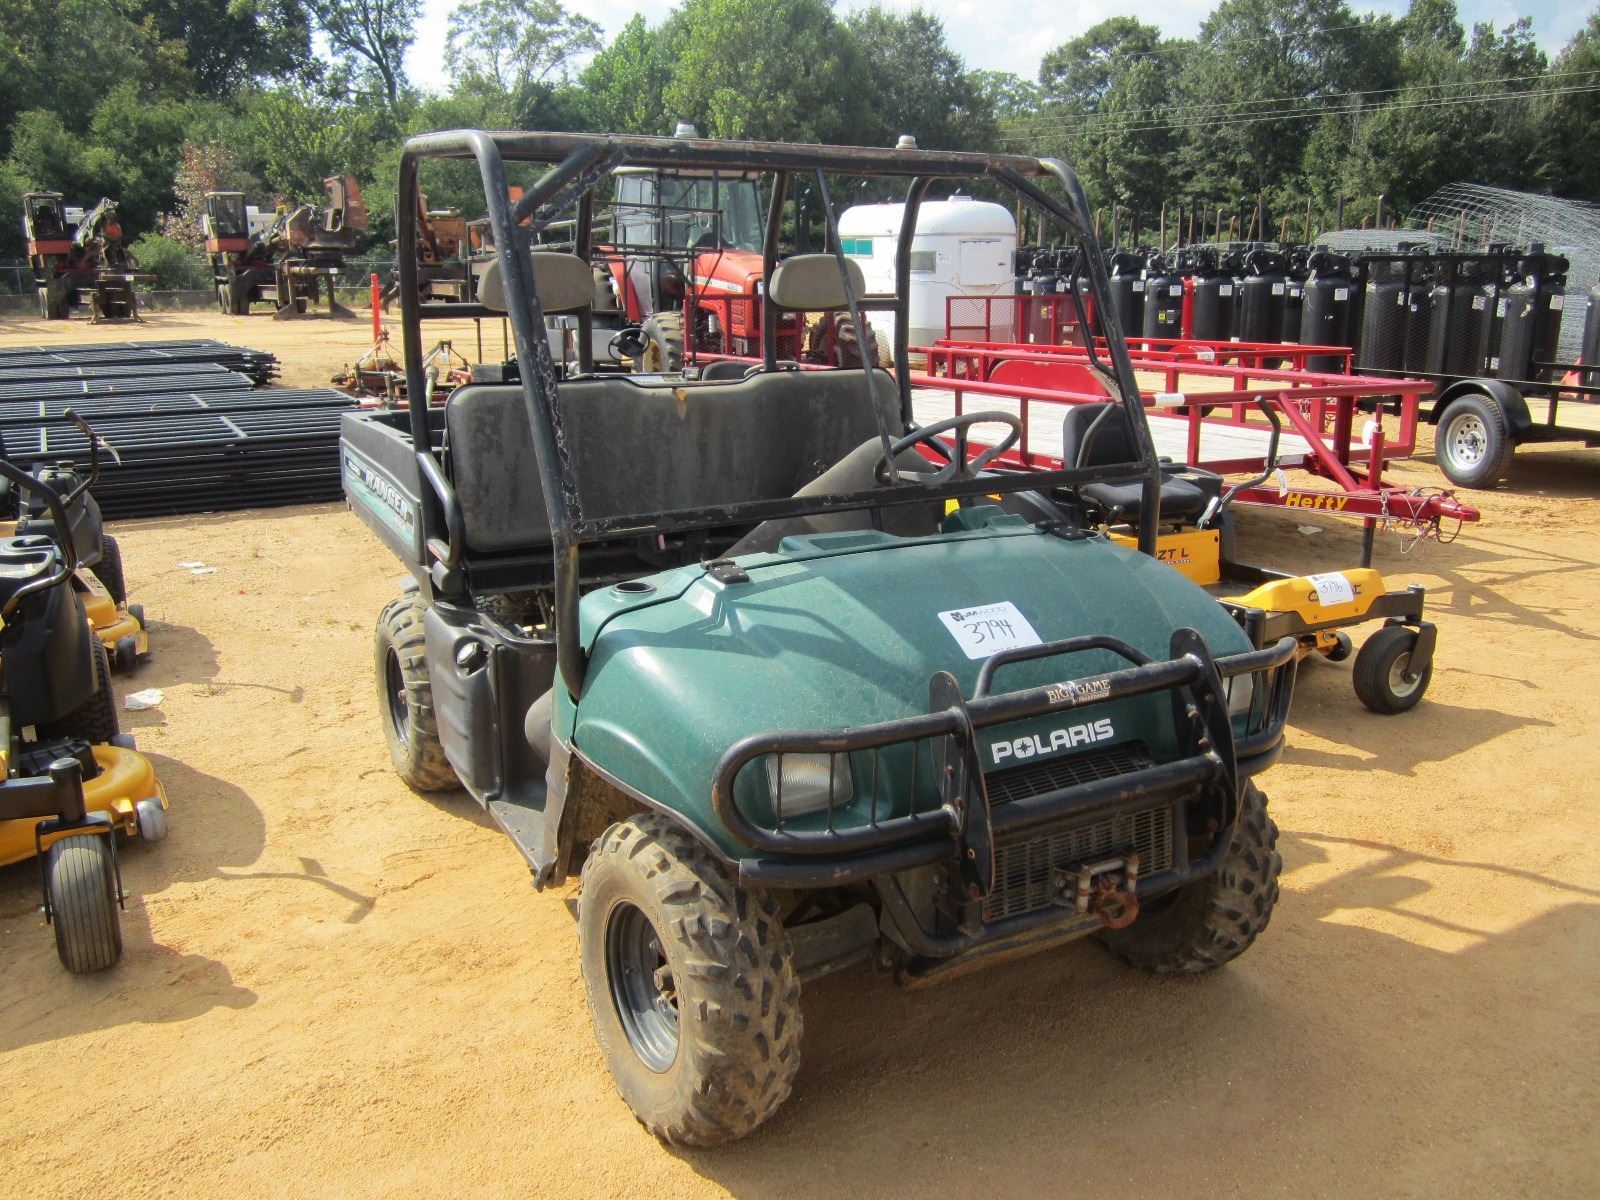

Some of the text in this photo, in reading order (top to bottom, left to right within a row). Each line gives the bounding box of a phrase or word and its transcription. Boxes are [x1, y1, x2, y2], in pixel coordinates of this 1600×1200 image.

[365, 468, 407, 520] RANGER
[1285, 492, 1348, 511] Hefty
[1155, 547, 1189, 560] ZT L
[963, 619, 1016, 644] 3794
[1047, 688, 1070, 701] BIG
[1075, 679, 1110, 694] GAME
[991, 718, 1115, 764] POLARIS
